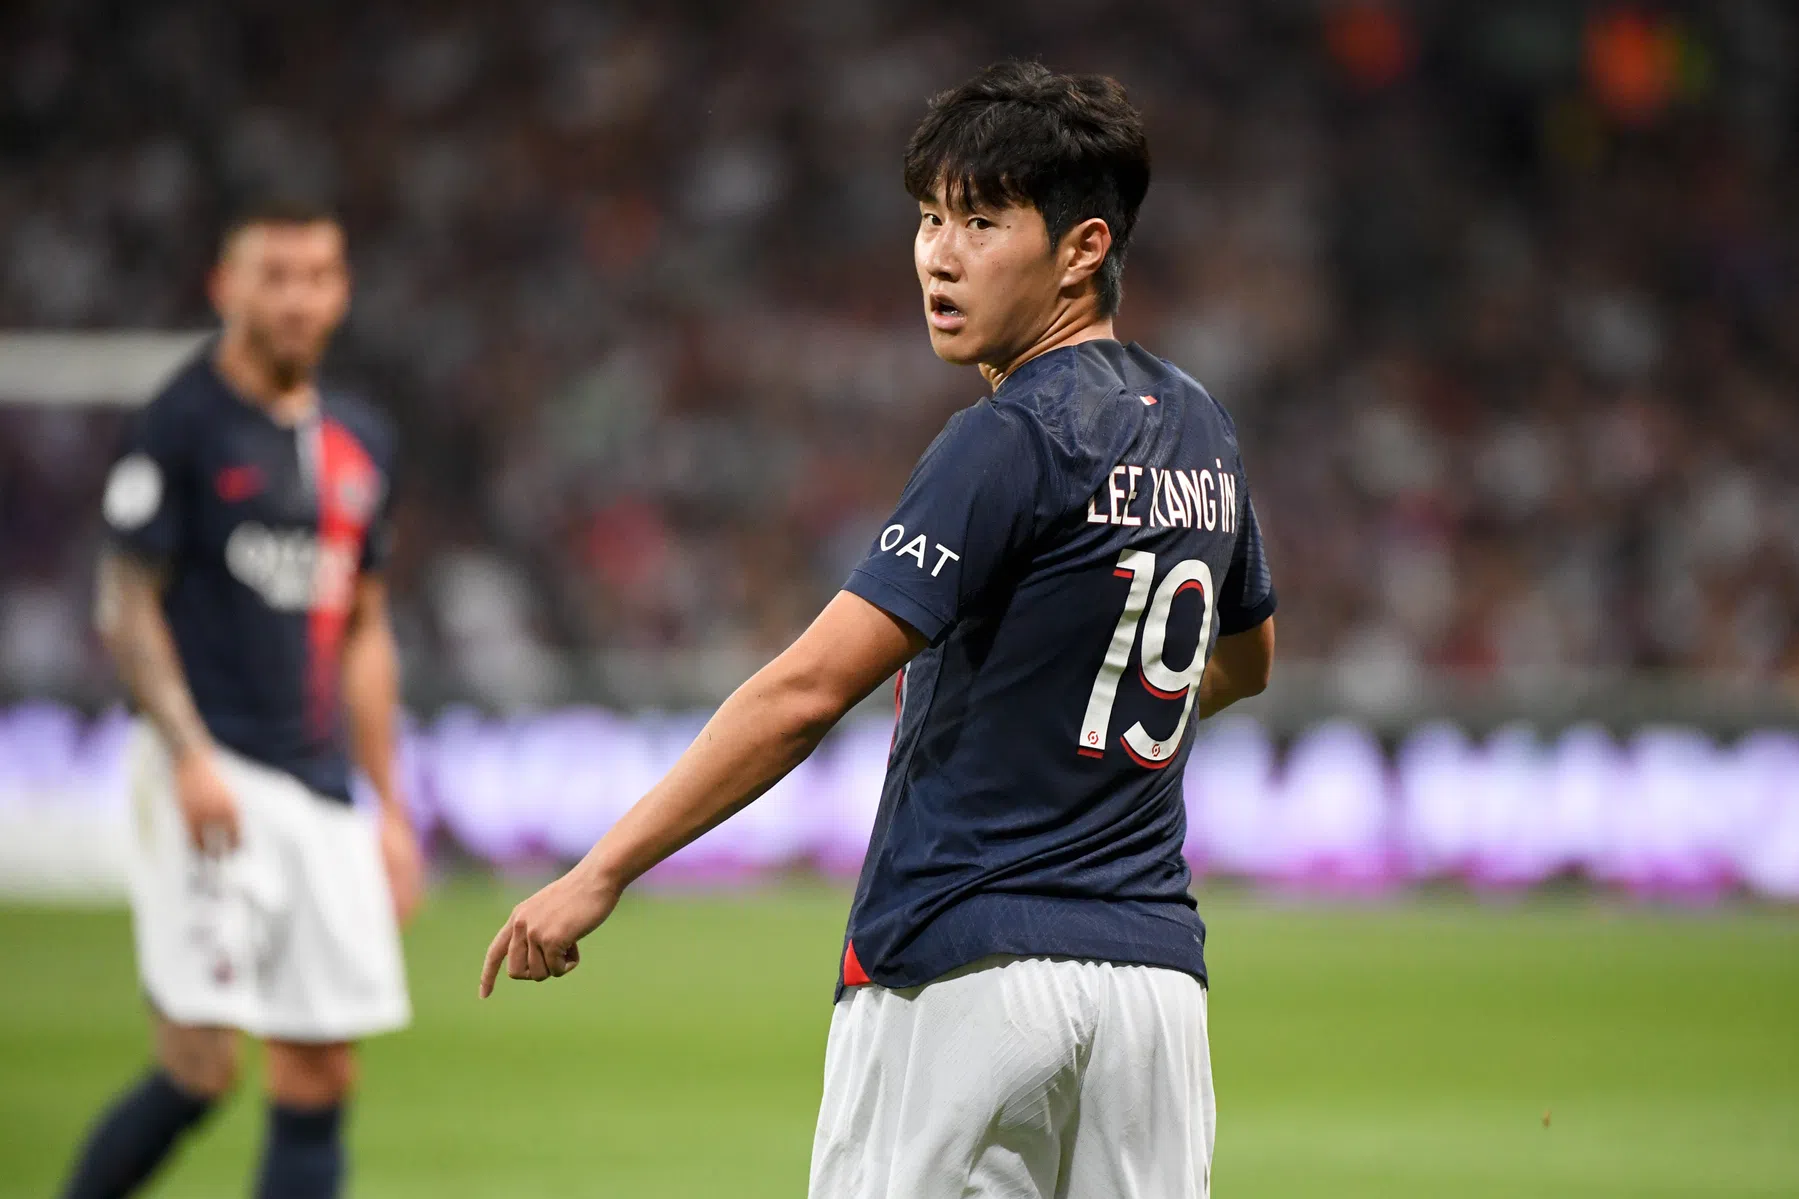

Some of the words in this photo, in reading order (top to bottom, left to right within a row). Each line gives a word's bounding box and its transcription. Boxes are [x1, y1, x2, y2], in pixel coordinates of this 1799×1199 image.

[1087, 465, 1143, 526] LEE
[1150, 467, 1217, 532] KANG
[1078, 548, 1214, 769] 19
